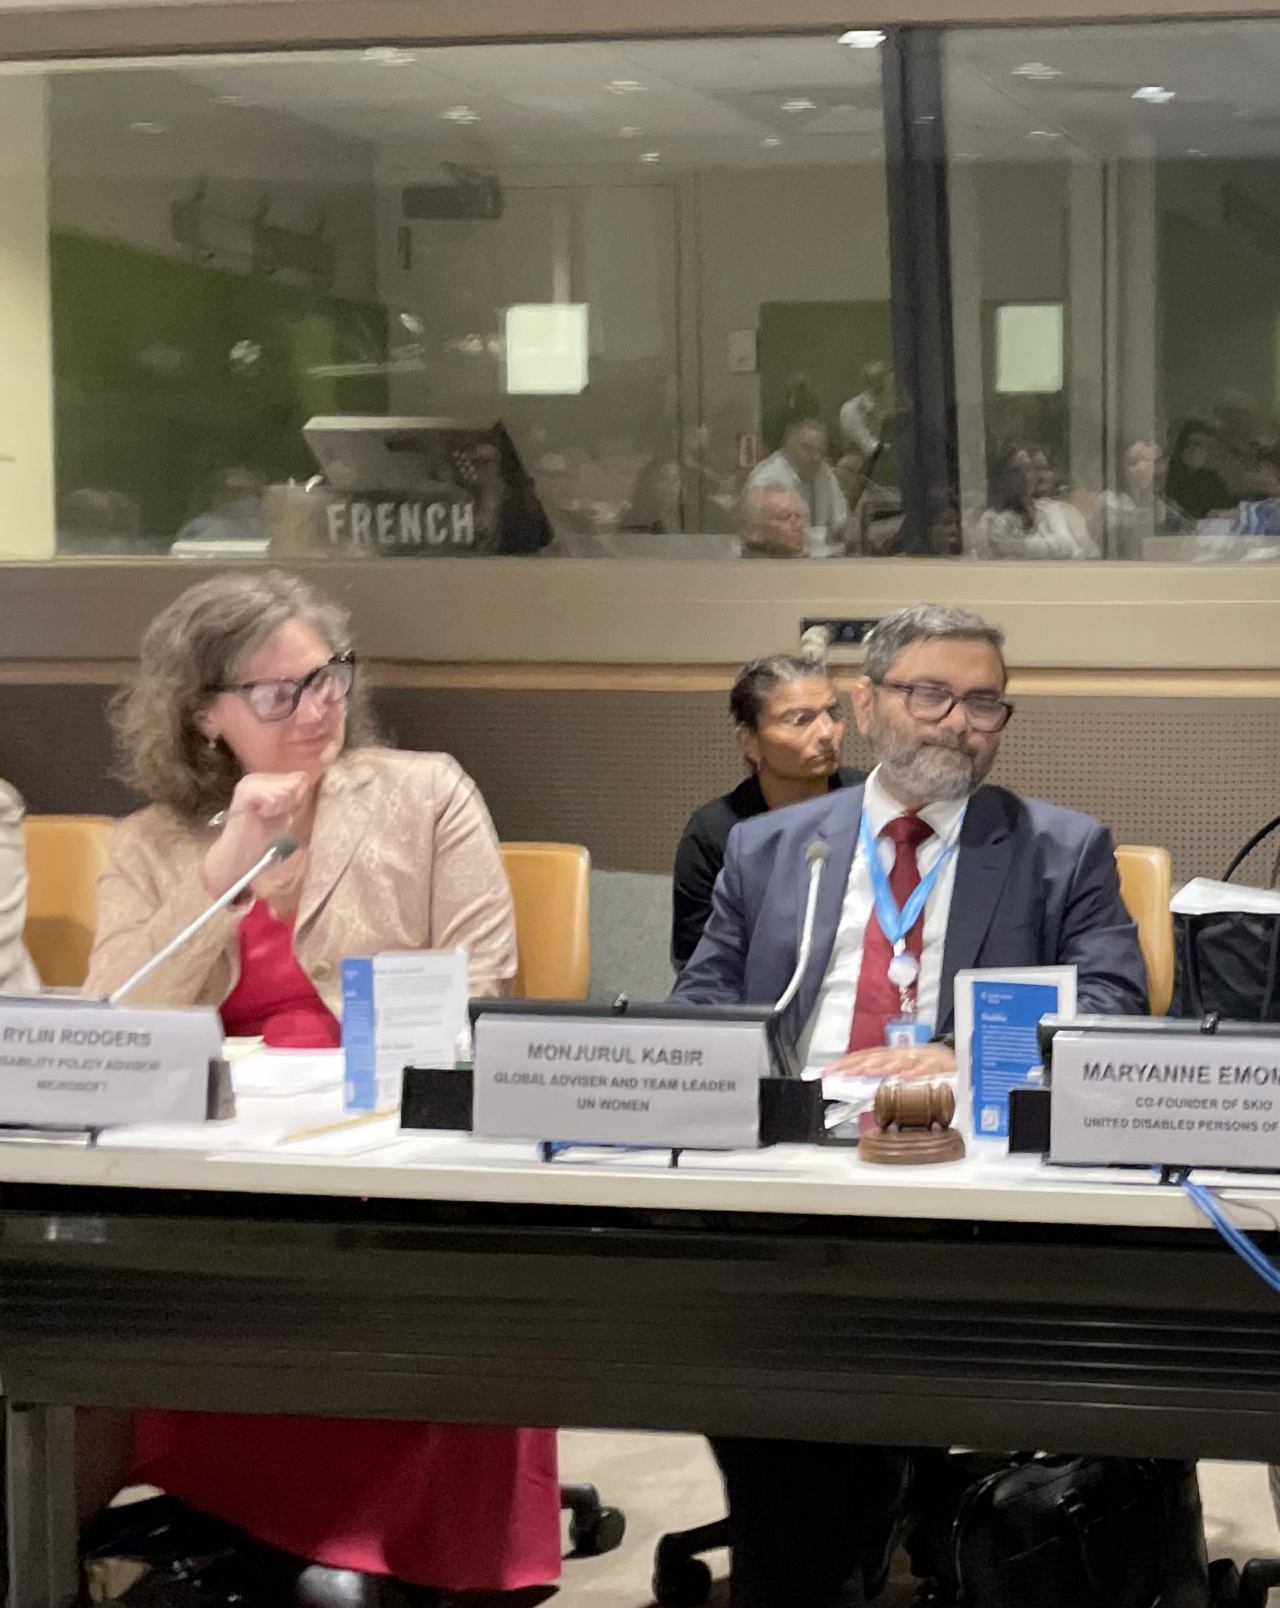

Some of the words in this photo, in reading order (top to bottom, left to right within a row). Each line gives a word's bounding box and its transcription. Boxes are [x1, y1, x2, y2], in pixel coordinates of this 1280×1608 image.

[326, 502, 475, 544] FRENCH
[3, 1026, 55, 1044] RYLIN
[60, 1028, 152, 1047] RODGERS
[527, 1043, 636, 1065] MONJURUL
[641, 1048, 704, 1066] KABIR
[494, 1071, 547, 1086] GLOBAL
[550, 1074, 608, 1088] ADVISER
[610, 1076, 639, 1090] AND
[641, 1078, 678, 1091] TEAM
[682, 1079, 737, 1093] LEADER
[1082, 1063, 1211, 1085] MARYANNE
[576, 1098, 596, 1110] UN
[600, 1099, 650, 1112] WOMEN
[1135, 1097, 1219, 1109] CO-FOUNDER
[1221, 1100, 1239, 1109] OF
[1083, 1117, 1129, 1129] UNITED
[1131, 1118, 1195, 1131] DISABLED
[1198, 1120, 1259, 1132] PERSONS
[1262, 1122, 1280, 1132] OF
